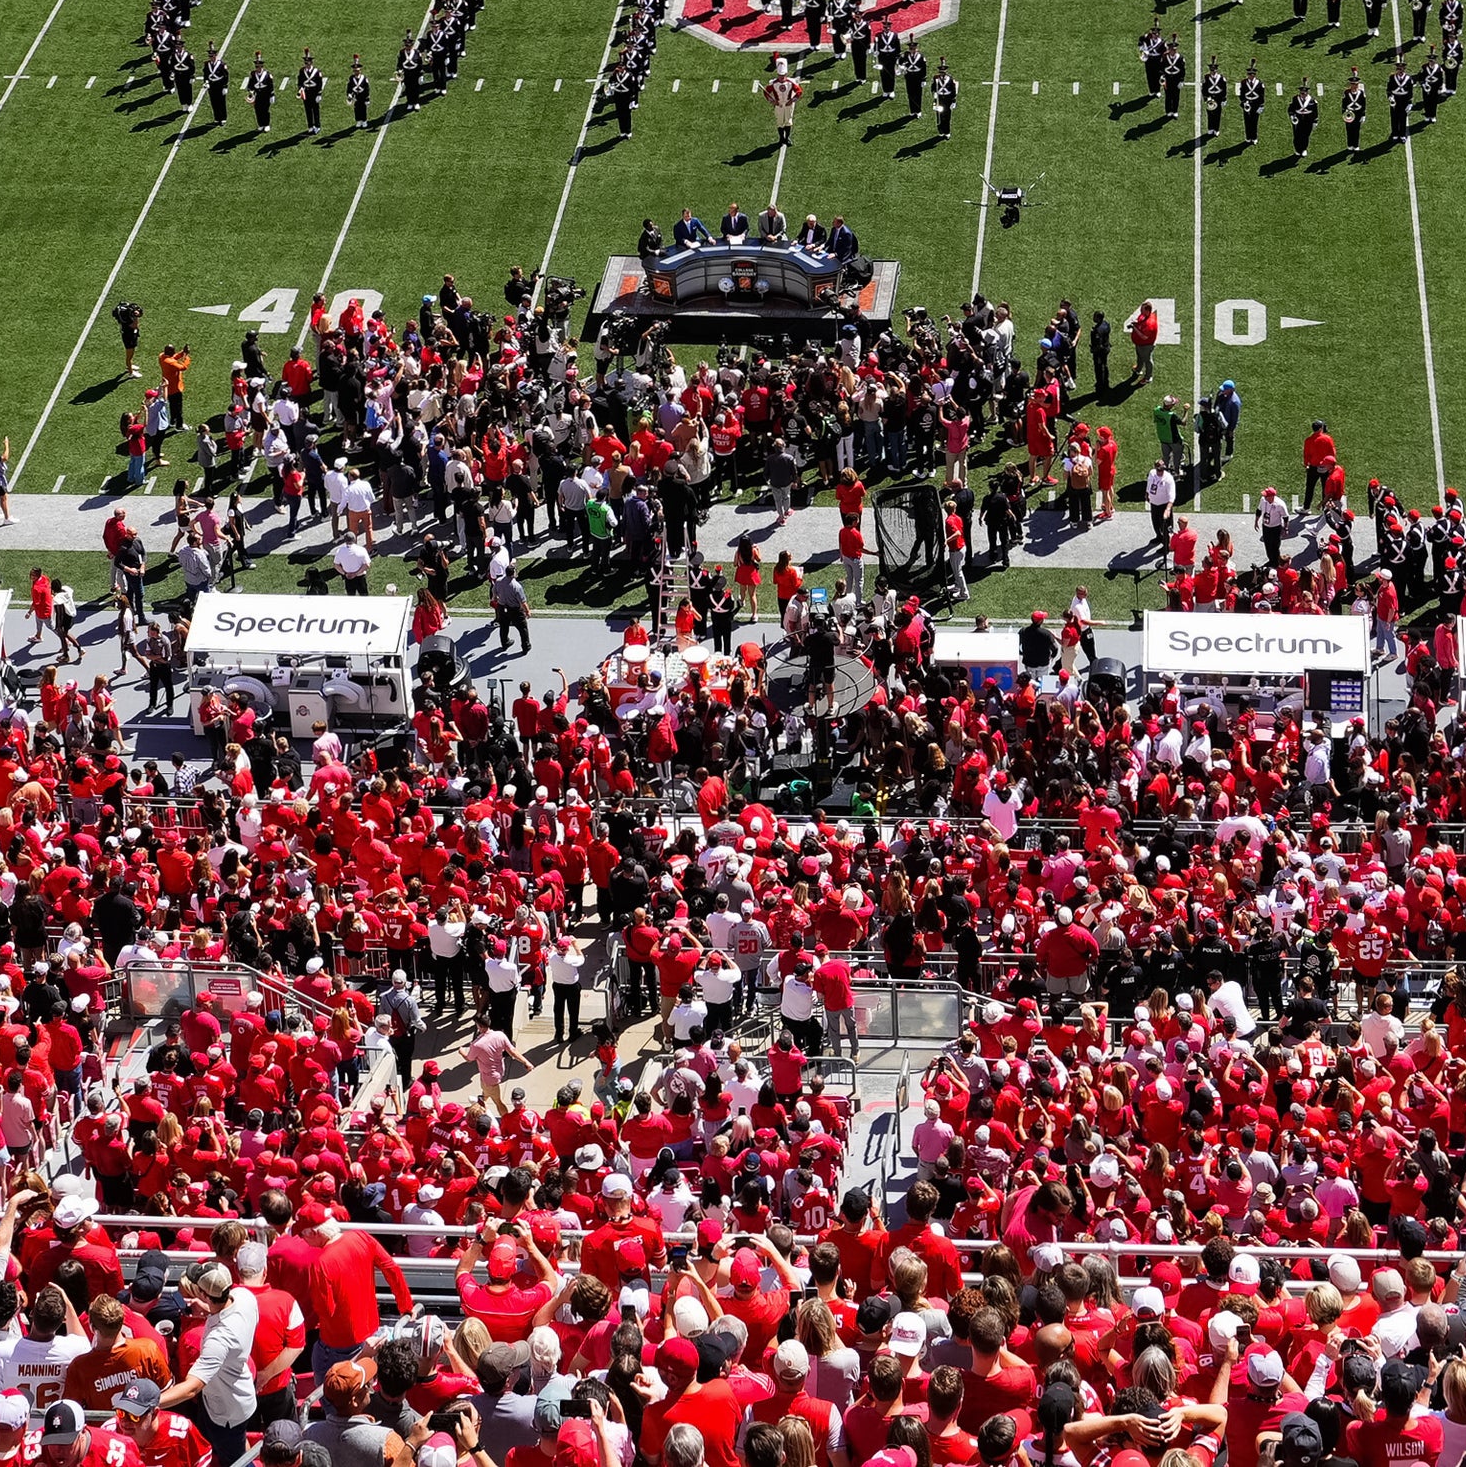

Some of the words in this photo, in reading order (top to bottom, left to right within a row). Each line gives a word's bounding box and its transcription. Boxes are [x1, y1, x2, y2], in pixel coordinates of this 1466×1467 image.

[214, 610, 370, 636] Spectrum
[1168, 630, 1334, 657] Spectrum
[631, 665, 642, 676] G
[738, 939, 758, 954] 20
[1359, 939, 1384, 960] 25
[1307, 1047, 1324, 1065] 19
[157, 1089, 169, 1109] 5
[474, 1145, 489, 1153] SMITH
[519, 1141, 534, 1150] SMITH
[475, 1152, 490, 1169] 4
[1189, 1173, 1206, 1195] 4
[391, 1188, 402, 1211] 1
[804, 1205, 826, 1230] 10
[18, 1364, 62, 1377] MANNING
[94, 1369, 138, 1393] SIMMONS
[167, 1414, 190, 1440] 15
[1384, 1440, 1425, 1458] WILSON
